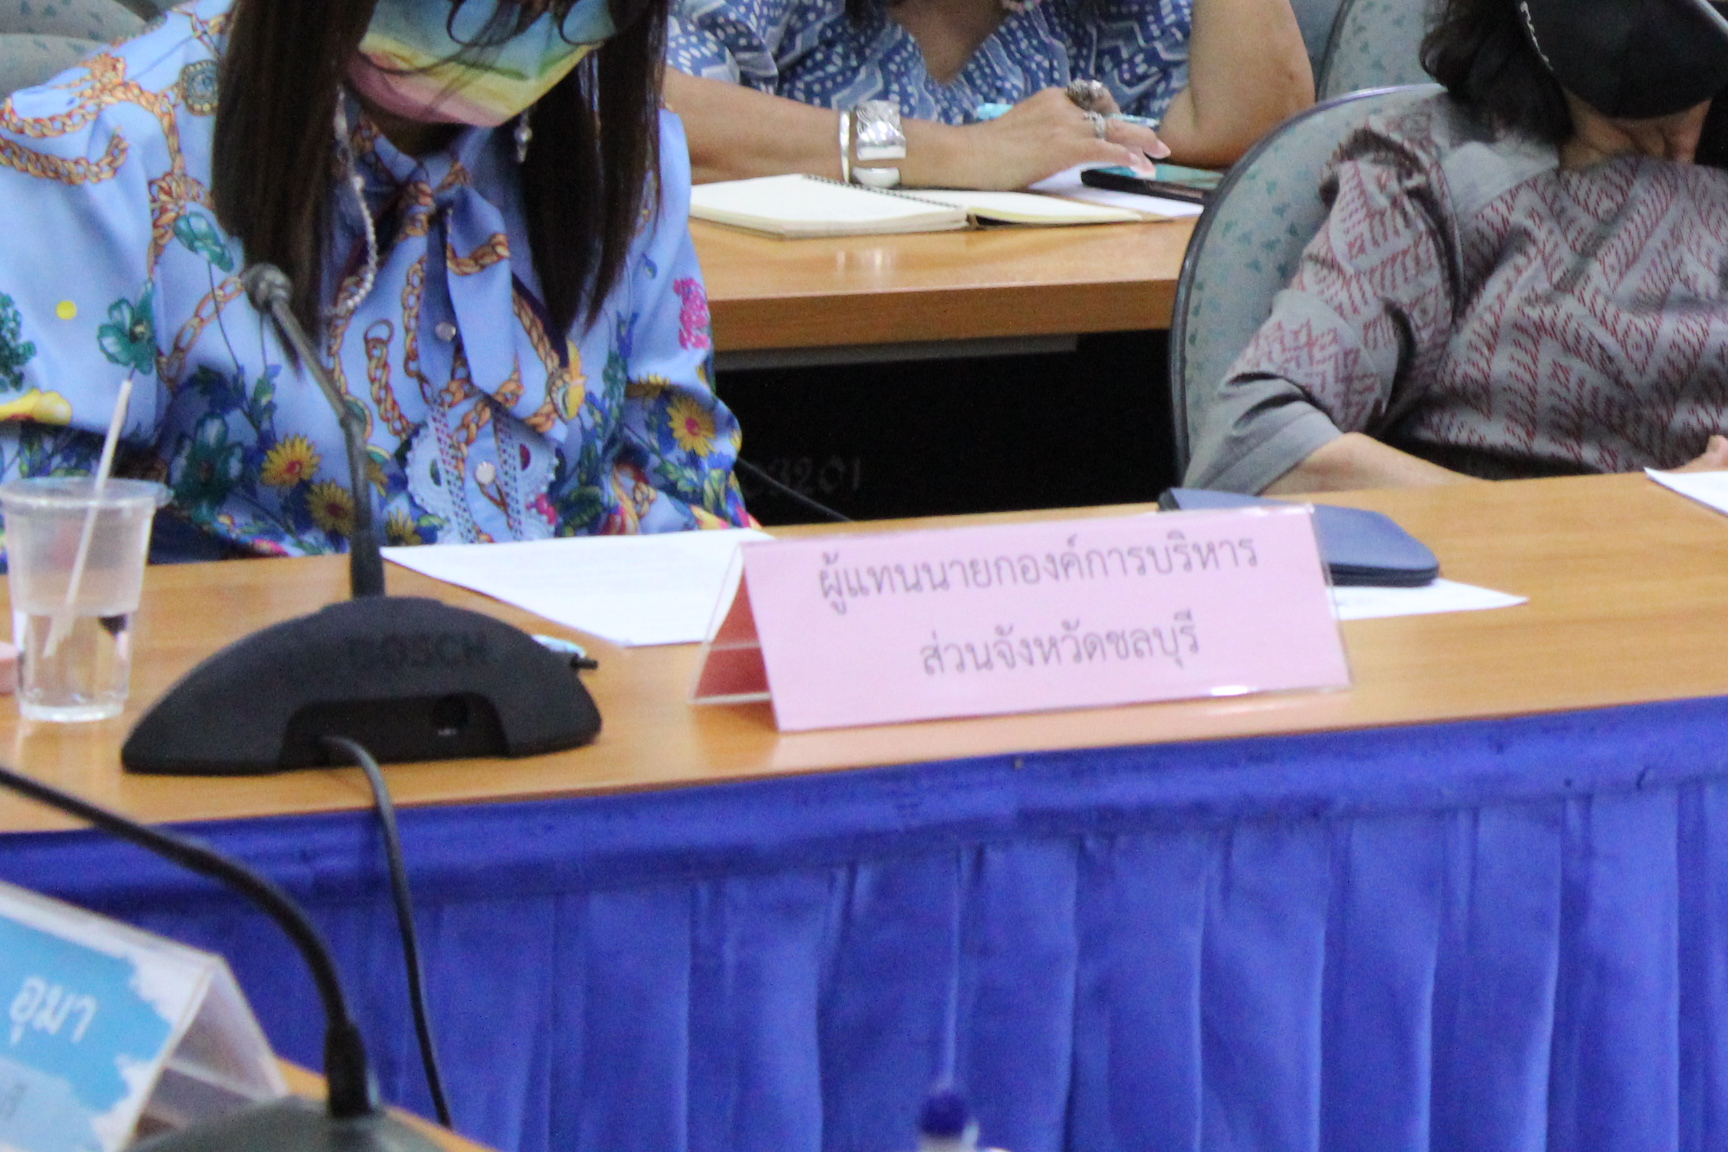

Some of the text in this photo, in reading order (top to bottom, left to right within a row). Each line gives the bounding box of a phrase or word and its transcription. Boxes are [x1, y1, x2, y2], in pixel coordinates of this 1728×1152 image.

[818, 529, 1259, 616] ผู้แทนนายกองค์การบริหาร
[920, 609, 1200, 676] ส่วนจังหวัดชลบุรี
[8, 973, 98, 1046] อุมา
